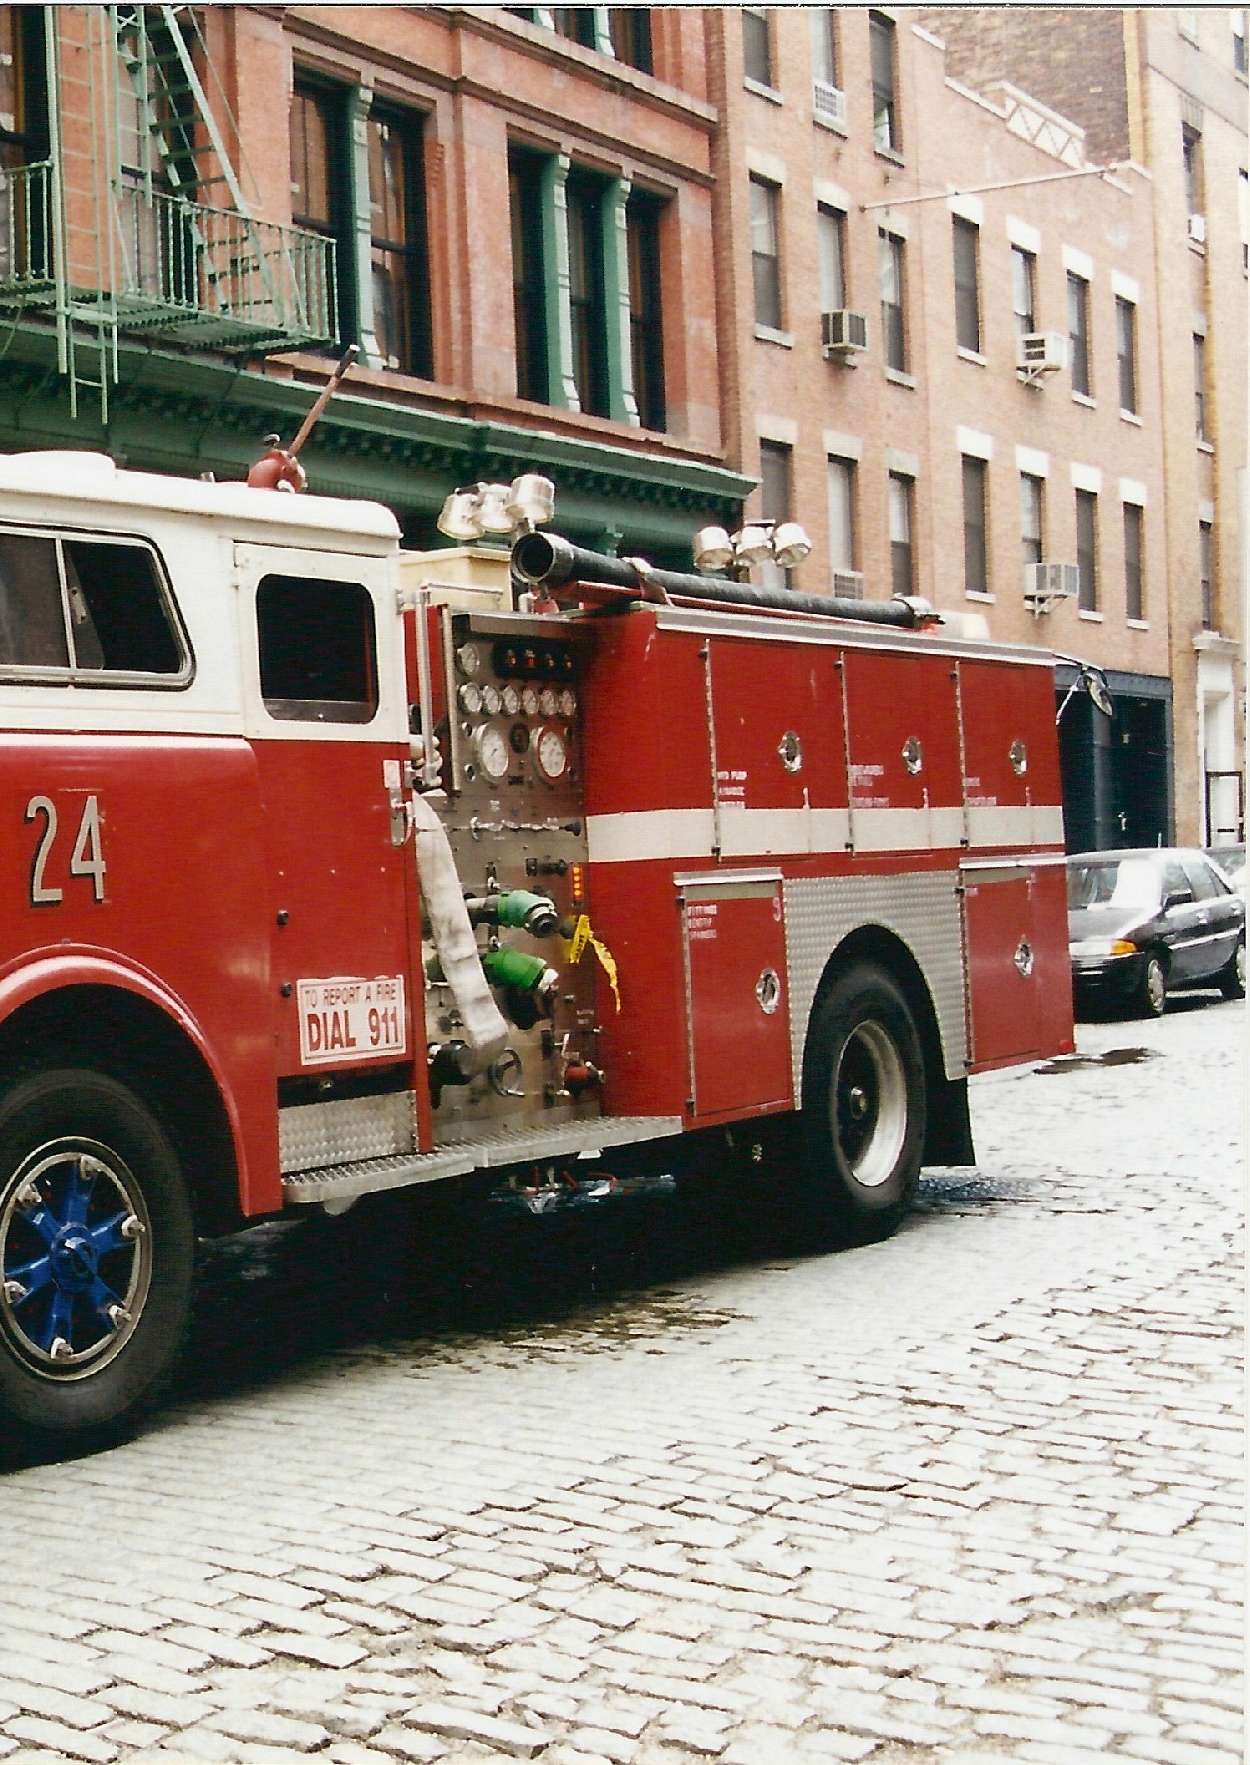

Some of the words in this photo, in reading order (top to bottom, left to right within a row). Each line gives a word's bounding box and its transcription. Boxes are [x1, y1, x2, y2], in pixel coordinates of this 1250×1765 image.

[24, 794, 107, 907] 24
[305, 989, 317, 1008] TO
[323, 985, 361, 1006] REPORT
[365, 985, 371, 1002] A
[376, 982, 396, 1001] FIRE
[307, 1009, 356, 1052] DIAL
[368, 1005, 399, 1046] 911
